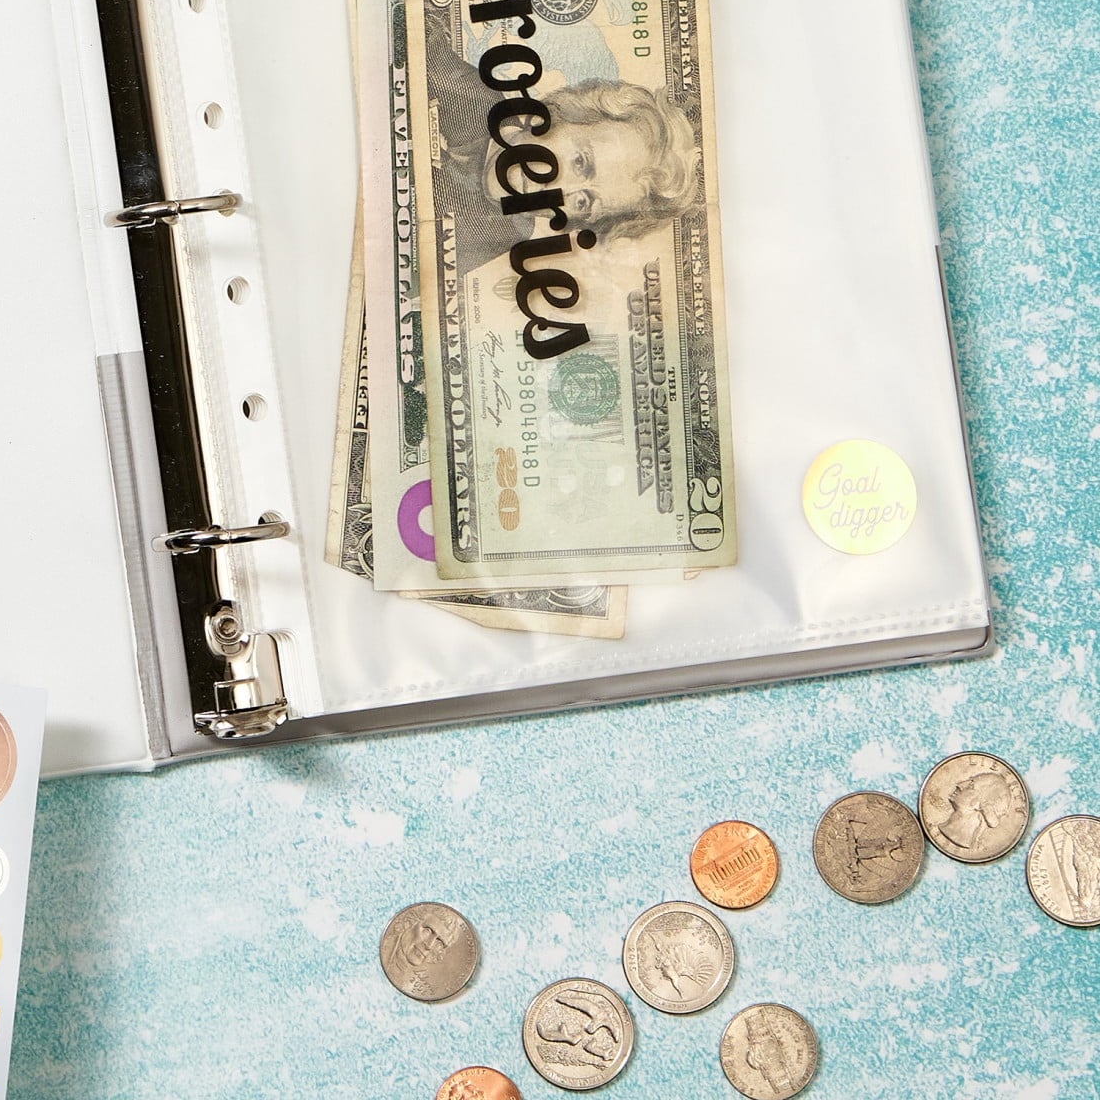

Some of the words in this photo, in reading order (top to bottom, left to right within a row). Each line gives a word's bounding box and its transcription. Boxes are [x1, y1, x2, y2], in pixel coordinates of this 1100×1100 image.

[540, 7, 573, 21] SYSTEM
[430, 110, 441, 158] JACKSON
[441, 211, 463, 374] TWENTY
[689, 228, 706, 336] RESERVE
[698, 370, 712, 430] NOTE
[668, 368, 678, 402] THE
[449, 382, 473, 550] DOLLARS
[495, 447, 520, 532] 20
[813, 463, 881, 509] Goal
[689, 476, 724, 552] 20
[830, 501, 909, 538] digger
